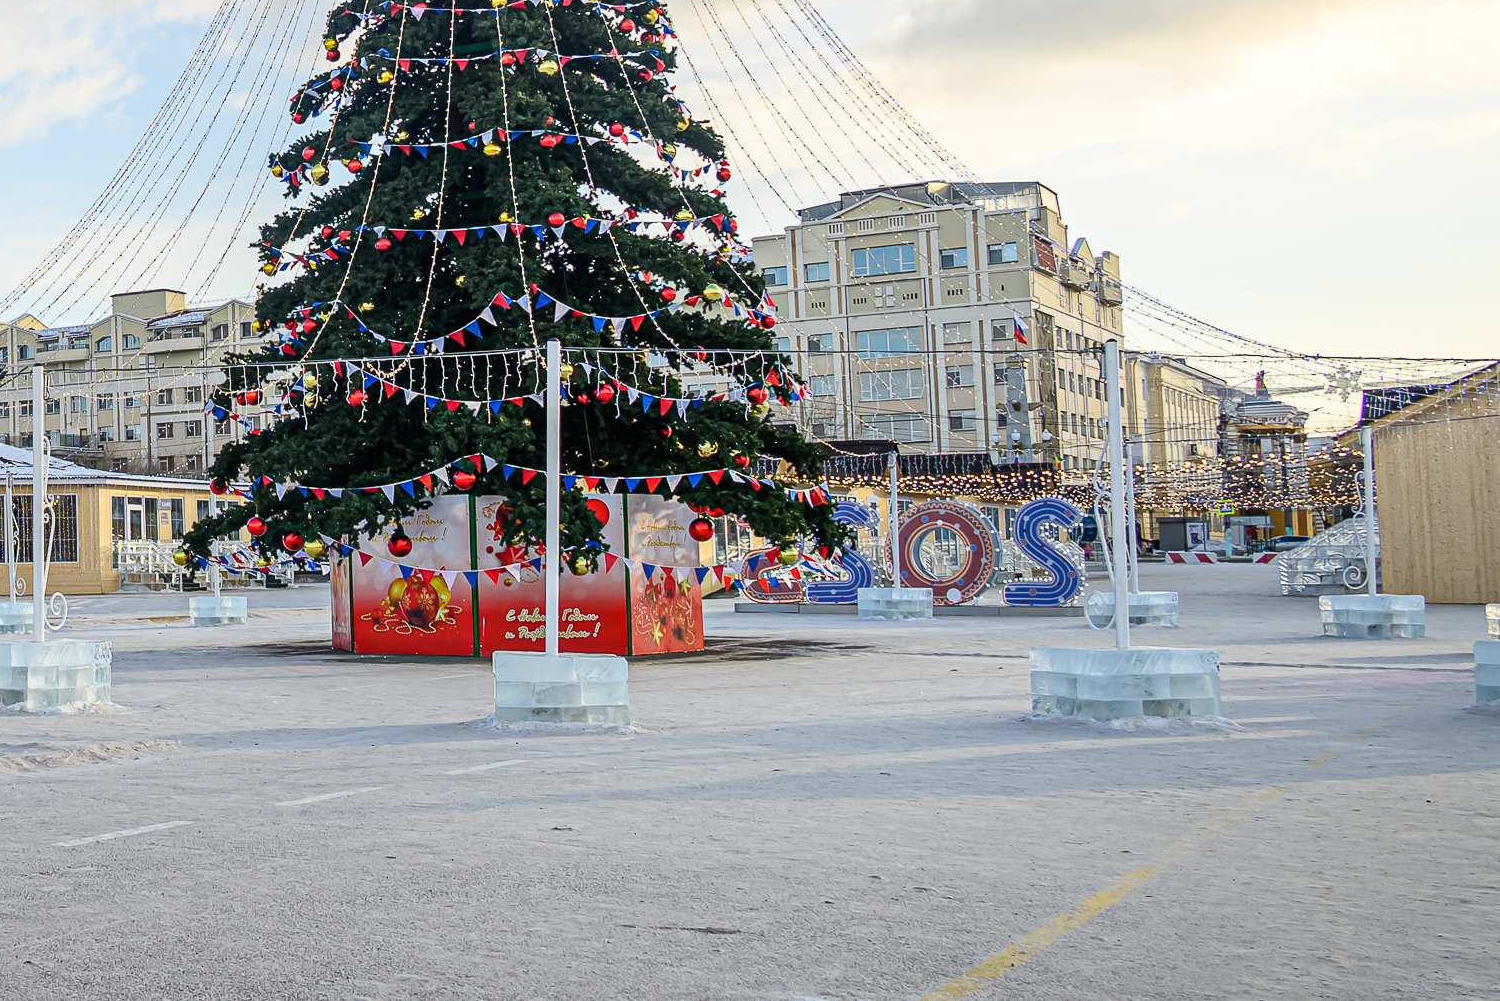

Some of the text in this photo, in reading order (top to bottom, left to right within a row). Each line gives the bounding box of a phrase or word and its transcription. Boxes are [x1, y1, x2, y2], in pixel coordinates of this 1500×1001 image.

[416, 514, 445, 525] Годом
[647, 519, 666, 531] Новым
[668, 520, 685, 531] Годом
[505, 609, 516, 622] С
[561, 607, 599, 621] Годом
[505, 631, 515, 639] и
